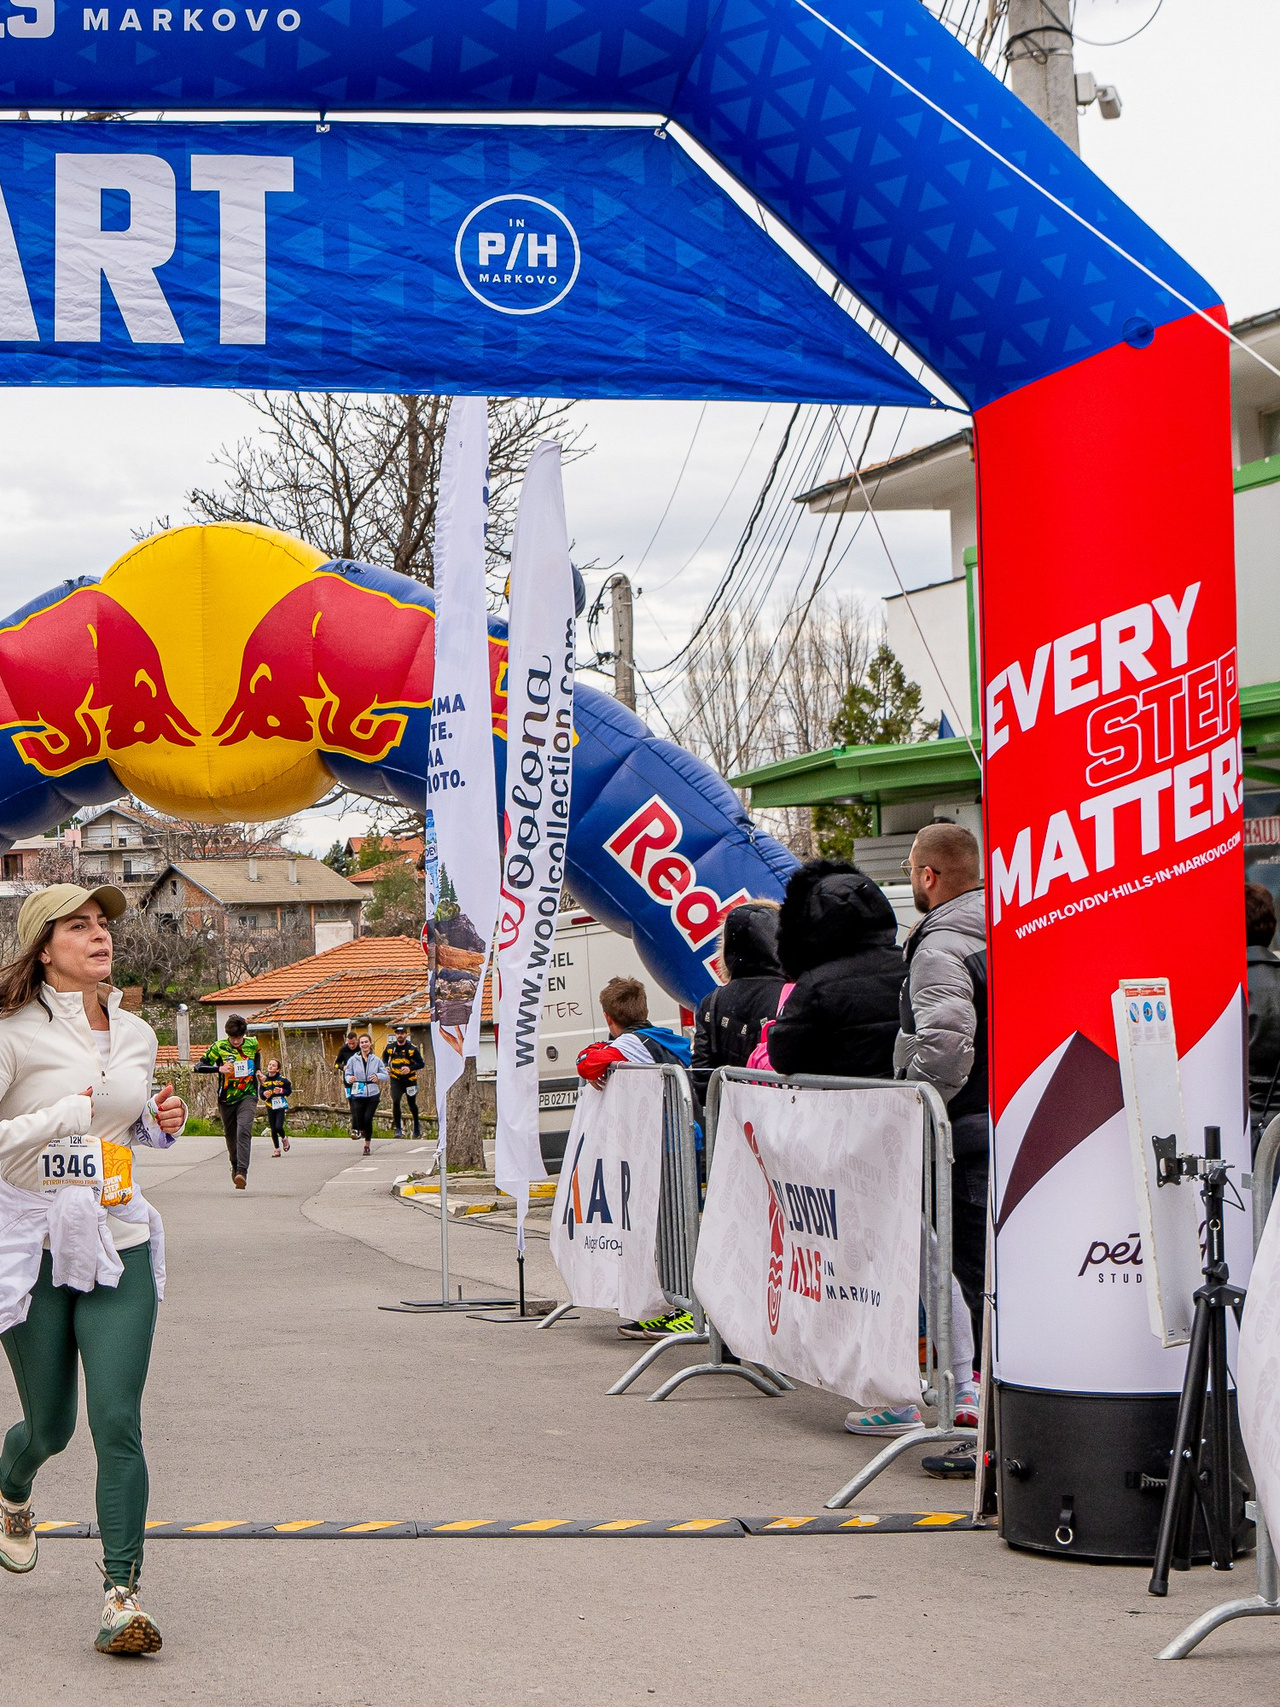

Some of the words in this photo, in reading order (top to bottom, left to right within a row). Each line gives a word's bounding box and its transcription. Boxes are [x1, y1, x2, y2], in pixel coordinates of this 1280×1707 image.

[83, 8, 301, 32] MARKOVO
[508, 218, 525, 228] IN
[478, 231, 557, 271] P/H
[479, 273, 558, 285] MARKOVO
[986, 581, 1201, 760] EVERY
[1085, 646, 1239, 788] STEP
[609, 801, 748, 945] Red
[541, 1001, 583, 1020] TER
[539, 1094, 550, 1106] PB
[552, 1093, 571, 1105] 0271
[42, 1154, 96, 1178] 1346
[824, 1260, 835, 1277] IN
[1098, 1273, 1143, 1283] STUD
